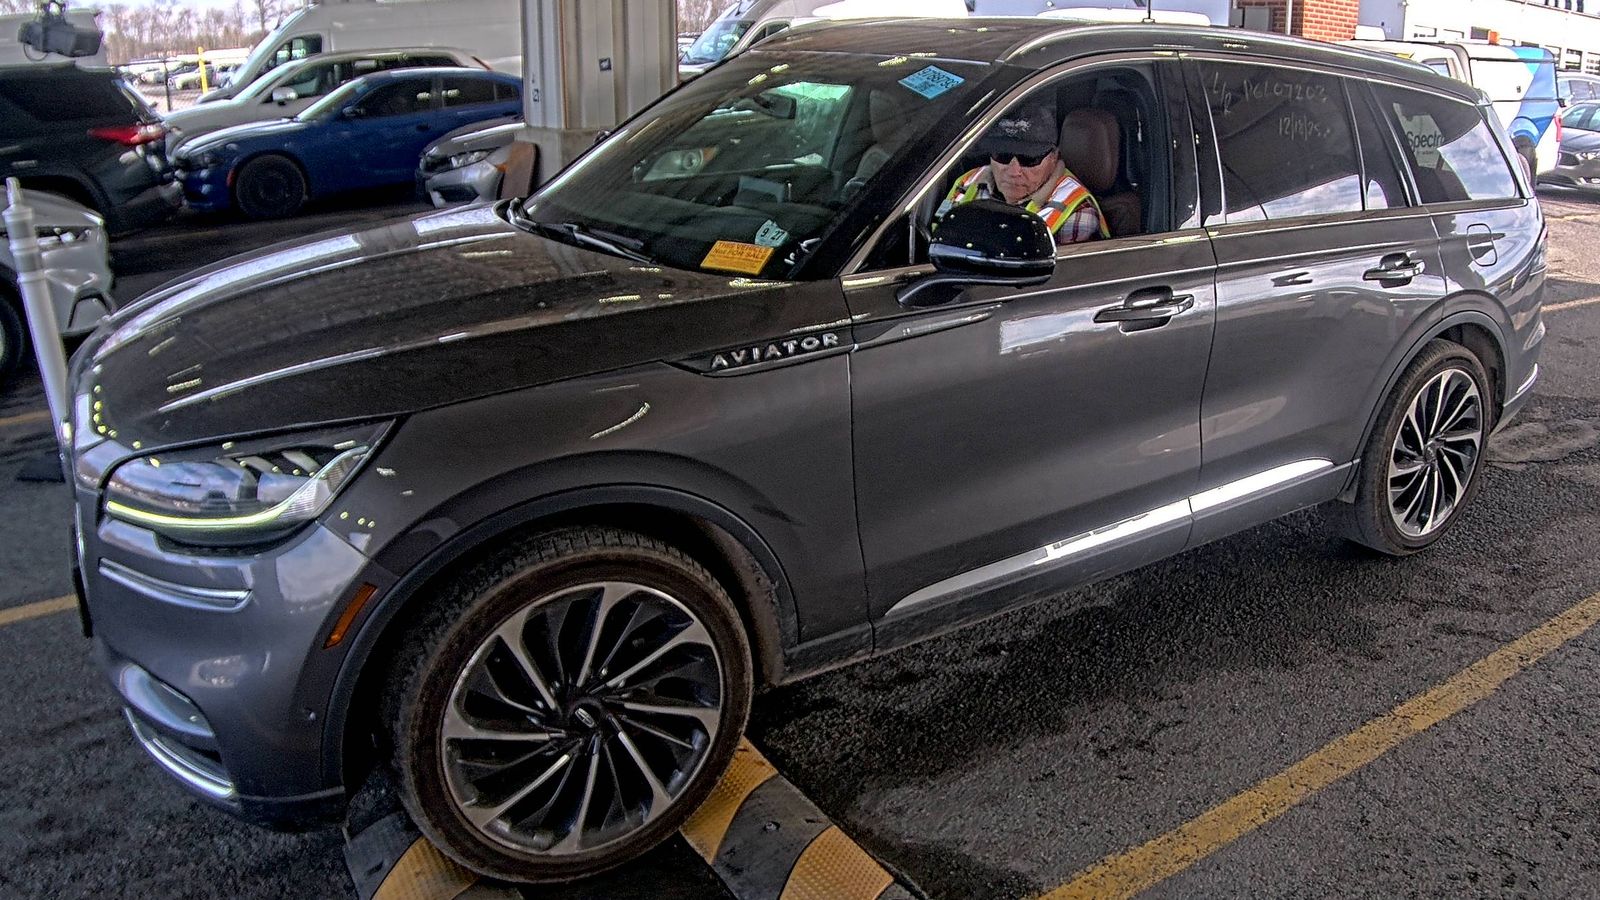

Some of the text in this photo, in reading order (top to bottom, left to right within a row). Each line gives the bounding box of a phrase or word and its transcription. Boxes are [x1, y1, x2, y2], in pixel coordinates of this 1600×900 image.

[761, 228, 784, 240] 9 27
[711, 333, 838, 368] AVIATOR
